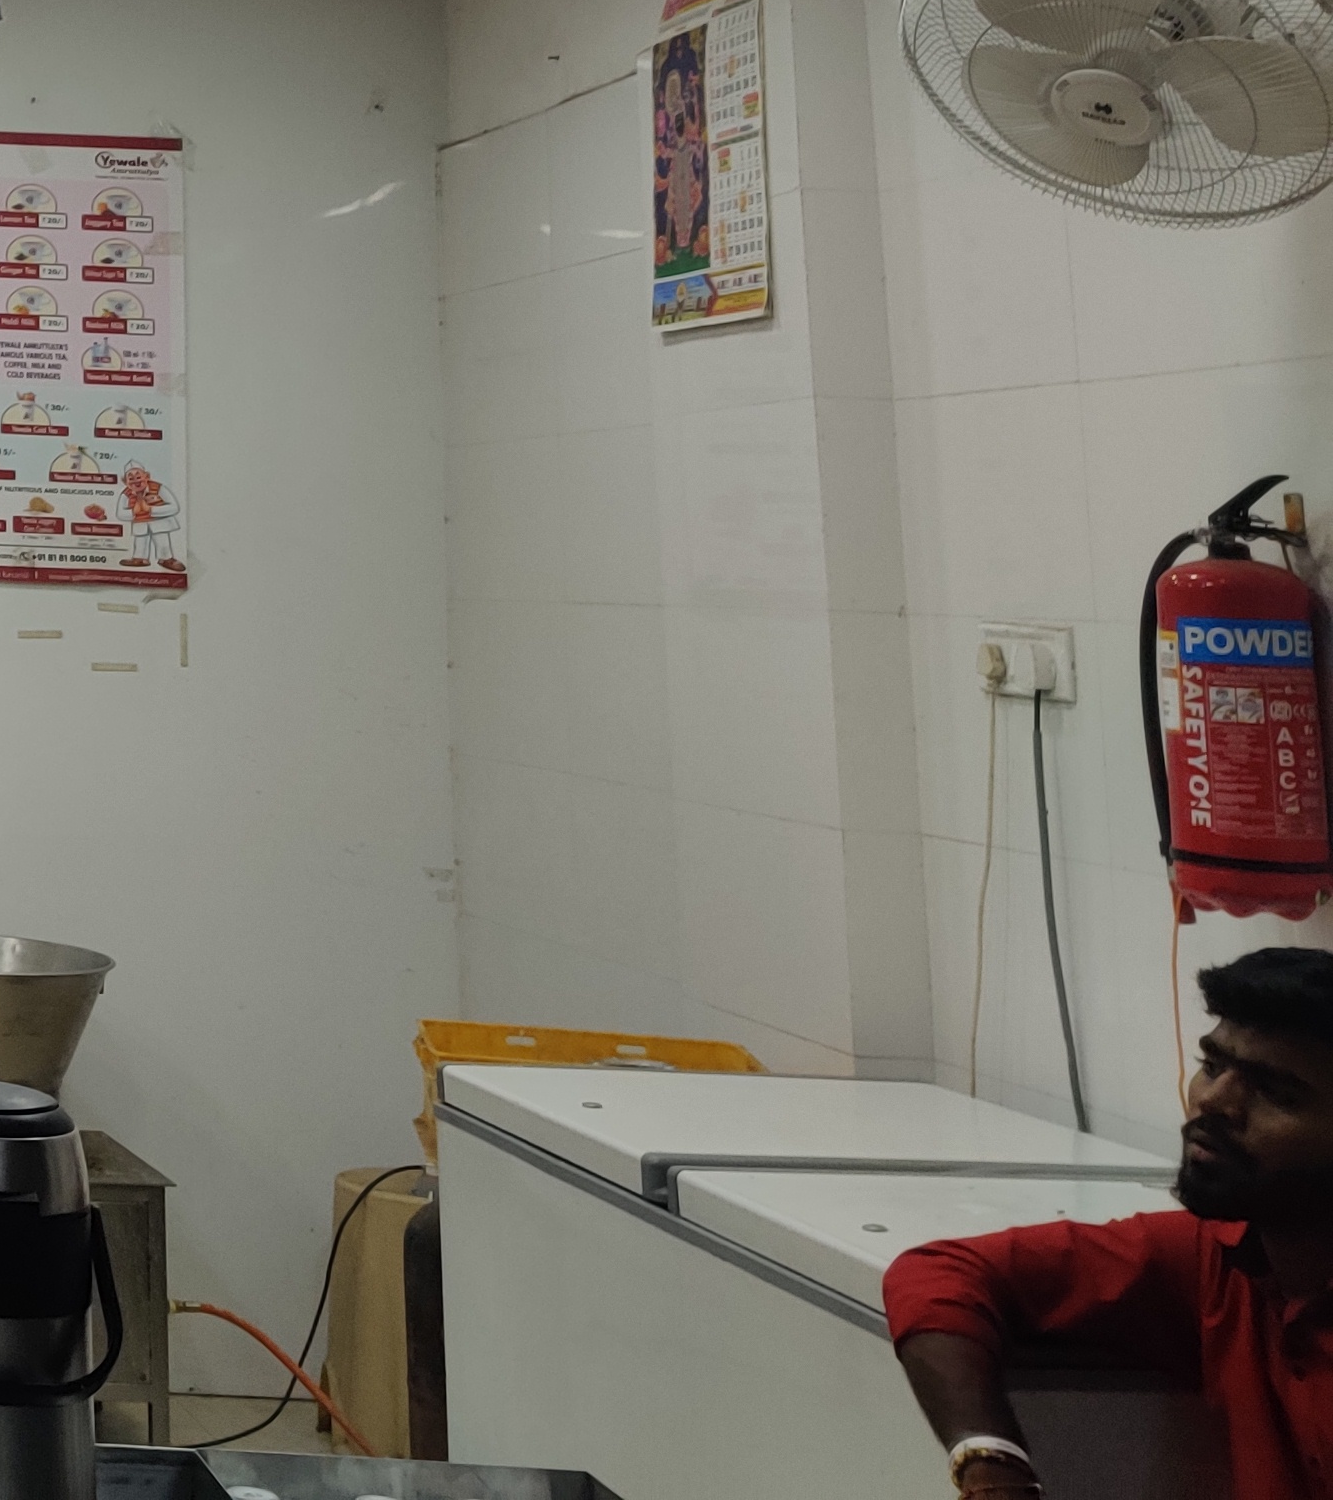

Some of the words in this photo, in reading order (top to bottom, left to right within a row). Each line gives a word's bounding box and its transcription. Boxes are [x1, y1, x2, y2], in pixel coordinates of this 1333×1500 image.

[95, 151, 148, 168] Yewale
[1184, 626, 1313, 658] POWDE
[1277, 727, 1294, 745] A
[1278, 750, 1295, 767] B
[1280, 771, 1296, 789] C
